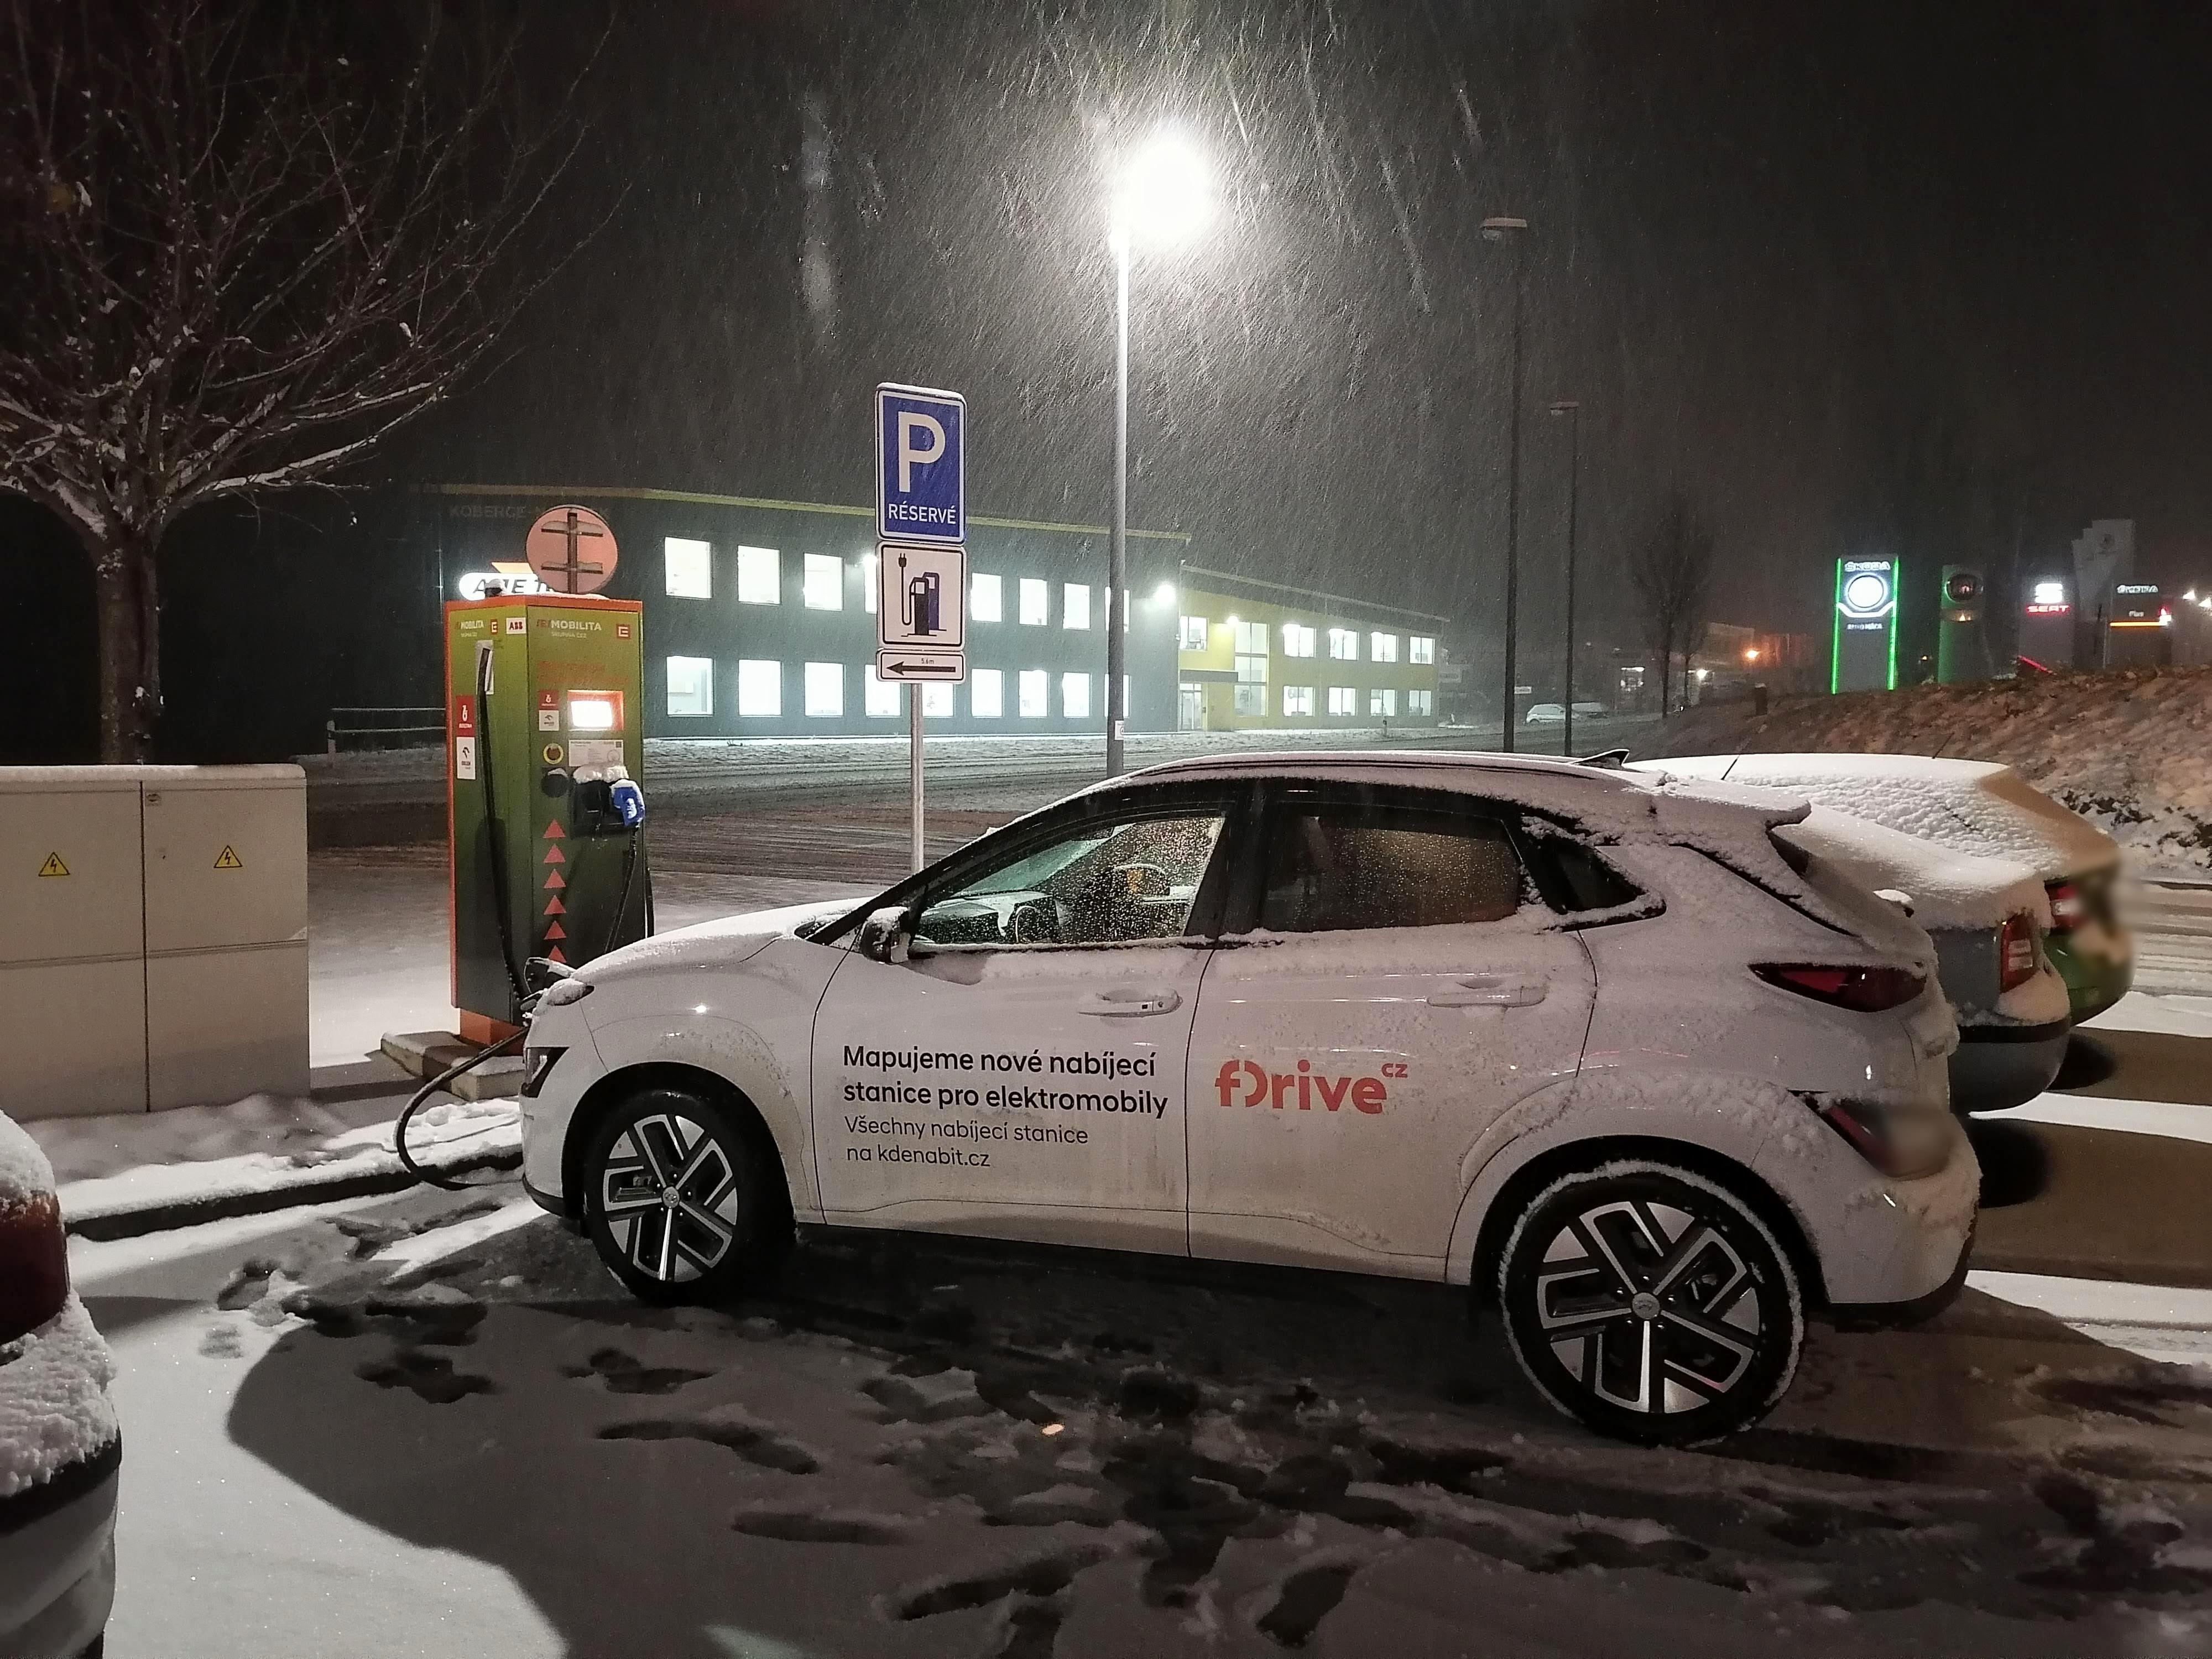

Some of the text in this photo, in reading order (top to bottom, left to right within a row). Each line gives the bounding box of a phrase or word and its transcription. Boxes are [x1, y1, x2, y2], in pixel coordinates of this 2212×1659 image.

[897, 411, 946, 493] P
[888, 501, 957, 525] RÉSERVÉ
[509, 622, 523, 630] ABB
[844, 1045, 1156, 1081] Mapujeme nové nabíjecí
[843, 1080, 1168, 1119] stanice pro elektromobily
[844, 1115, 1088, 1144] Všechny nabíjecí stanice
[847, 1144, 991, 1167] na kdenabit.cz
